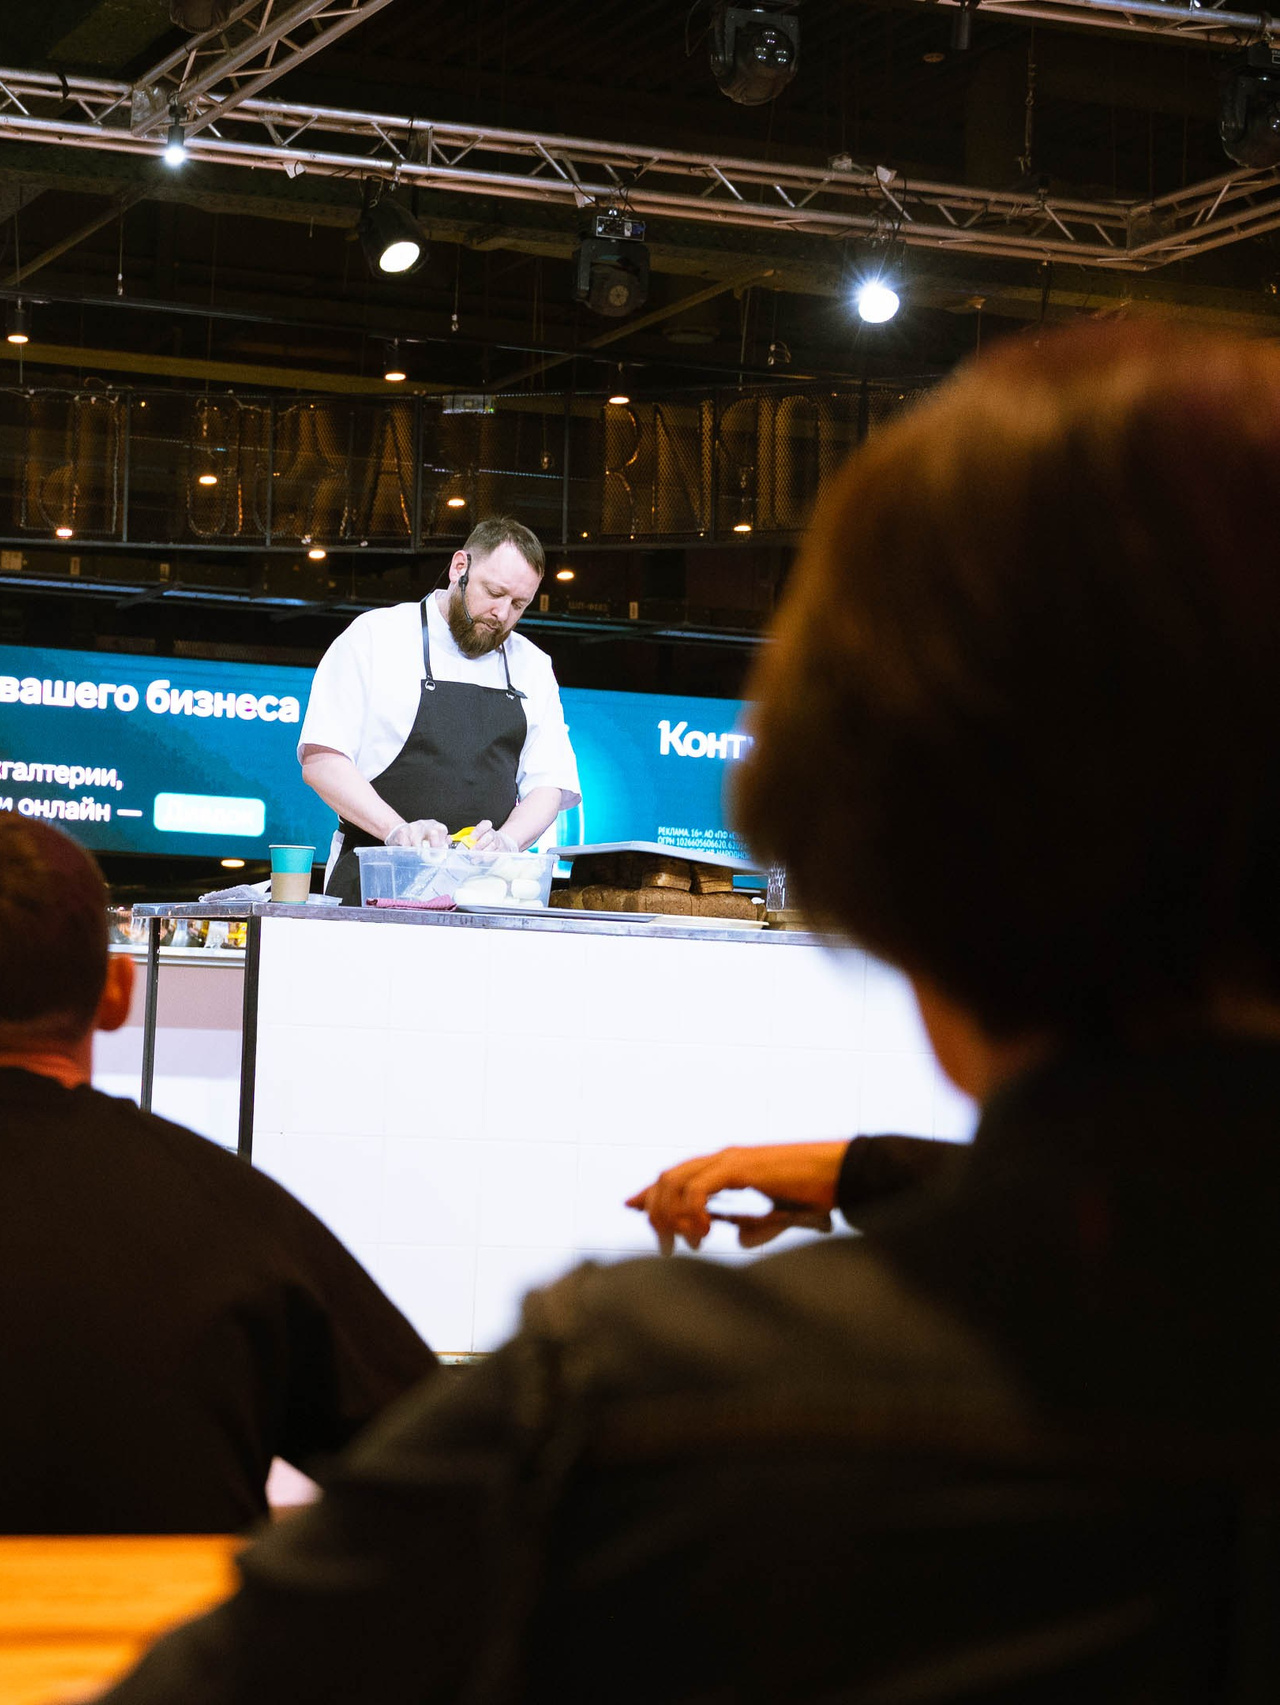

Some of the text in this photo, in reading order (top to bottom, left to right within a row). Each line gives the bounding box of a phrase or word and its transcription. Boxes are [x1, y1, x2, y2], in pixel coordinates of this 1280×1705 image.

[145, 679, 301, 724] бизнеса
[657, 719, 755, 760] Конт
[17, 796, 111, 823] онлайн
